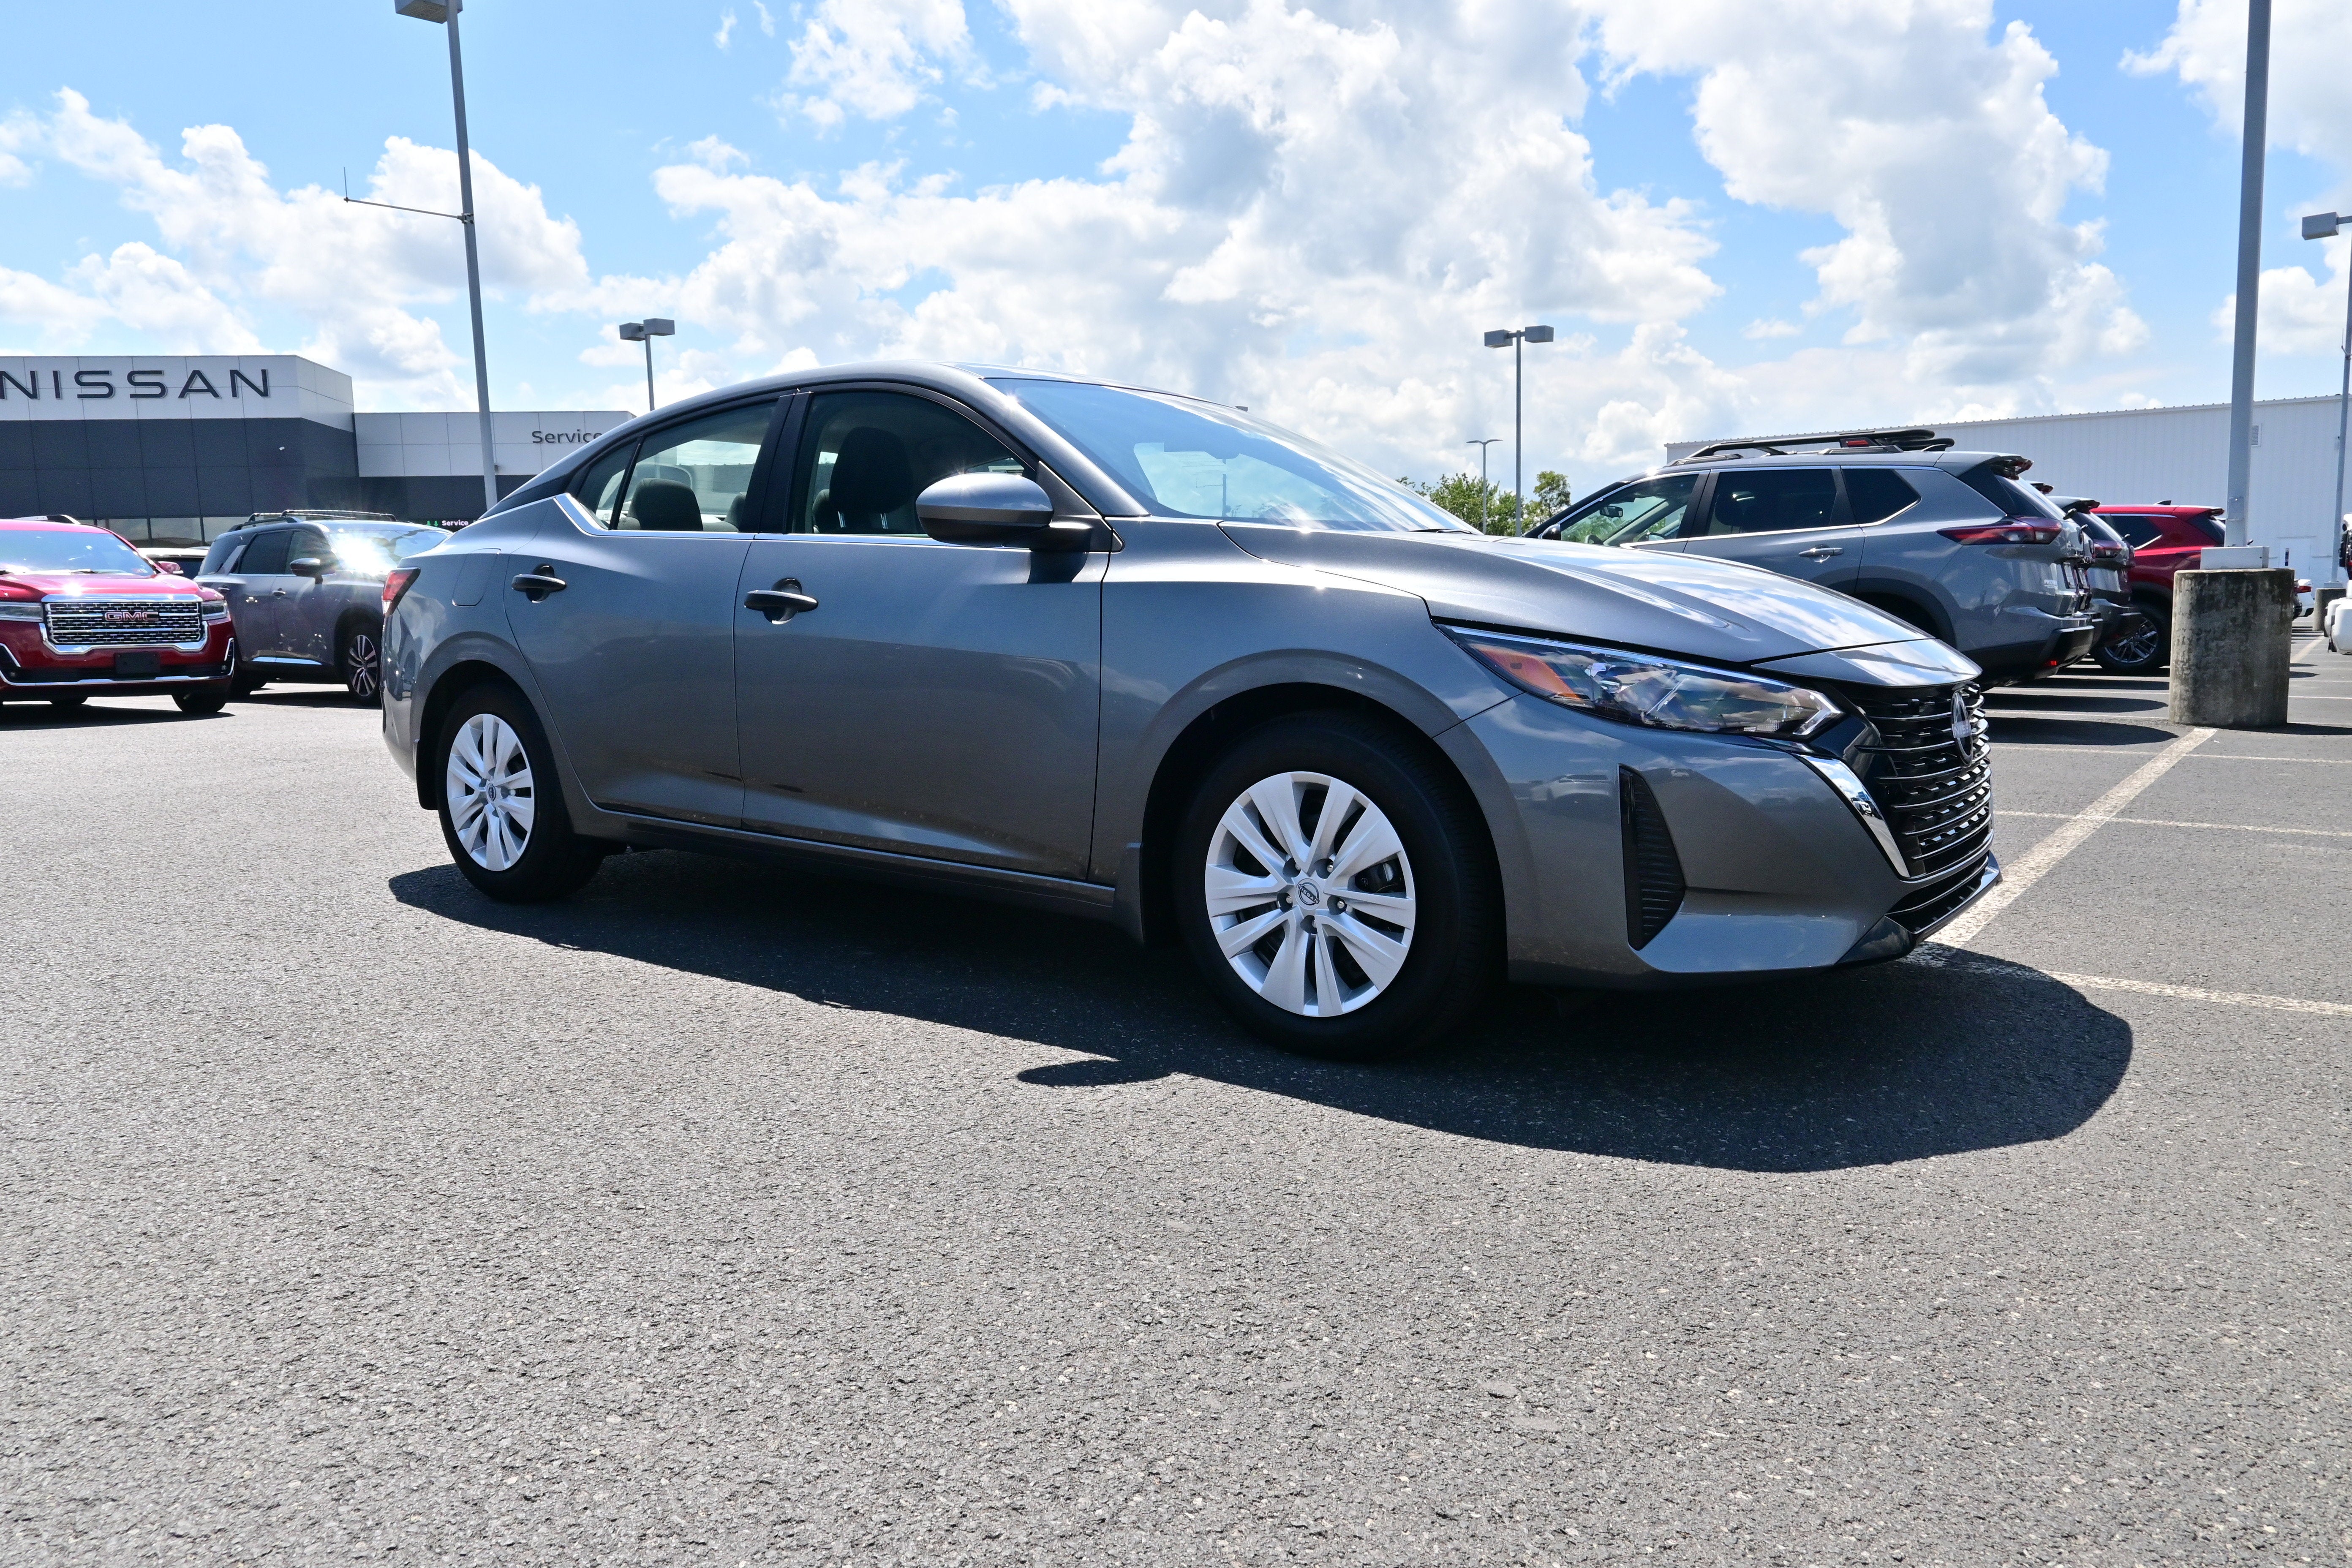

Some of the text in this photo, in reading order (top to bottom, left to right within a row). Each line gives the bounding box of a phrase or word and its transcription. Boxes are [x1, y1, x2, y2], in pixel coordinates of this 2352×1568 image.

[0, 369, 270, 400] NISSAN
[531, 429, 602, 444] Service
[105, 611, 159, 621] GMC
[1298, 884, 1319, 904] NISSAN
